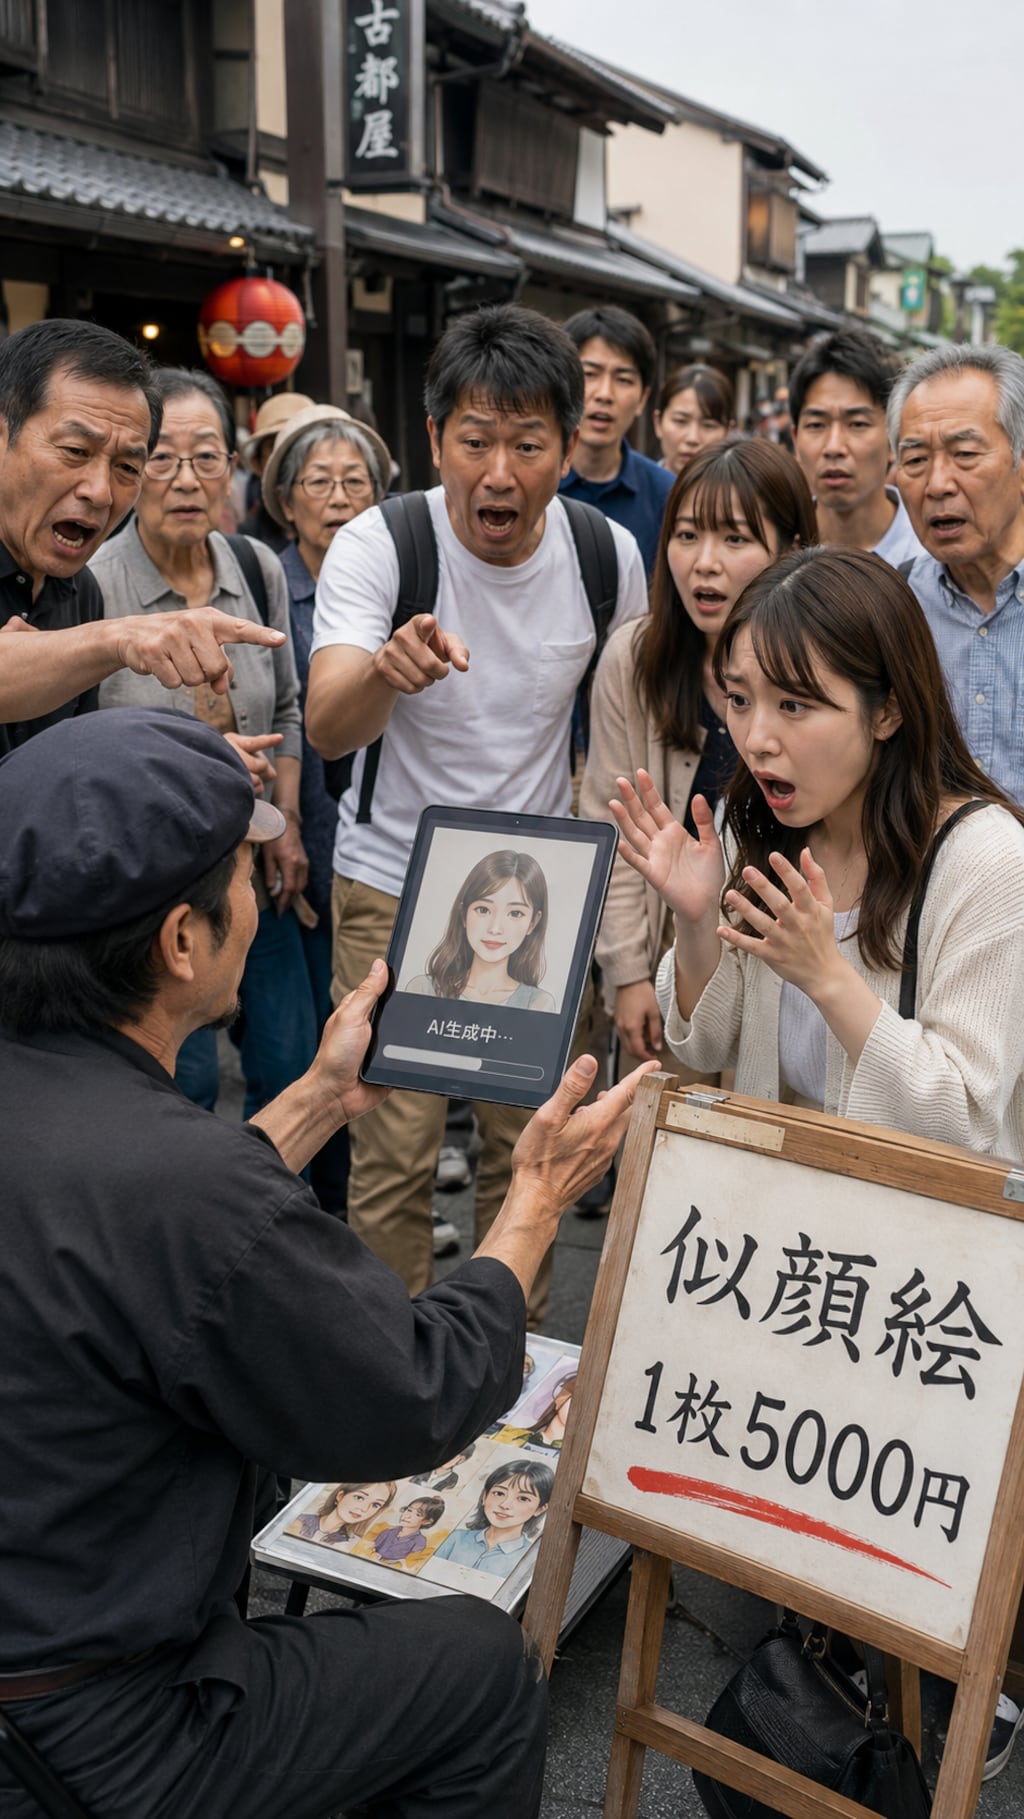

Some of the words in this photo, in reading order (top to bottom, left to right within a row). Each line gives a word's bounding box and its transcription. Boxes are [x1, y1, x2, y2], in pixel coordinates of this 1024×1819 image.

[354, 0, 400, 159] 古都屋
[660, 1205, 1003, 1400] 似顔絵
[634, 1361, 970, 1543] 1枚5000円
